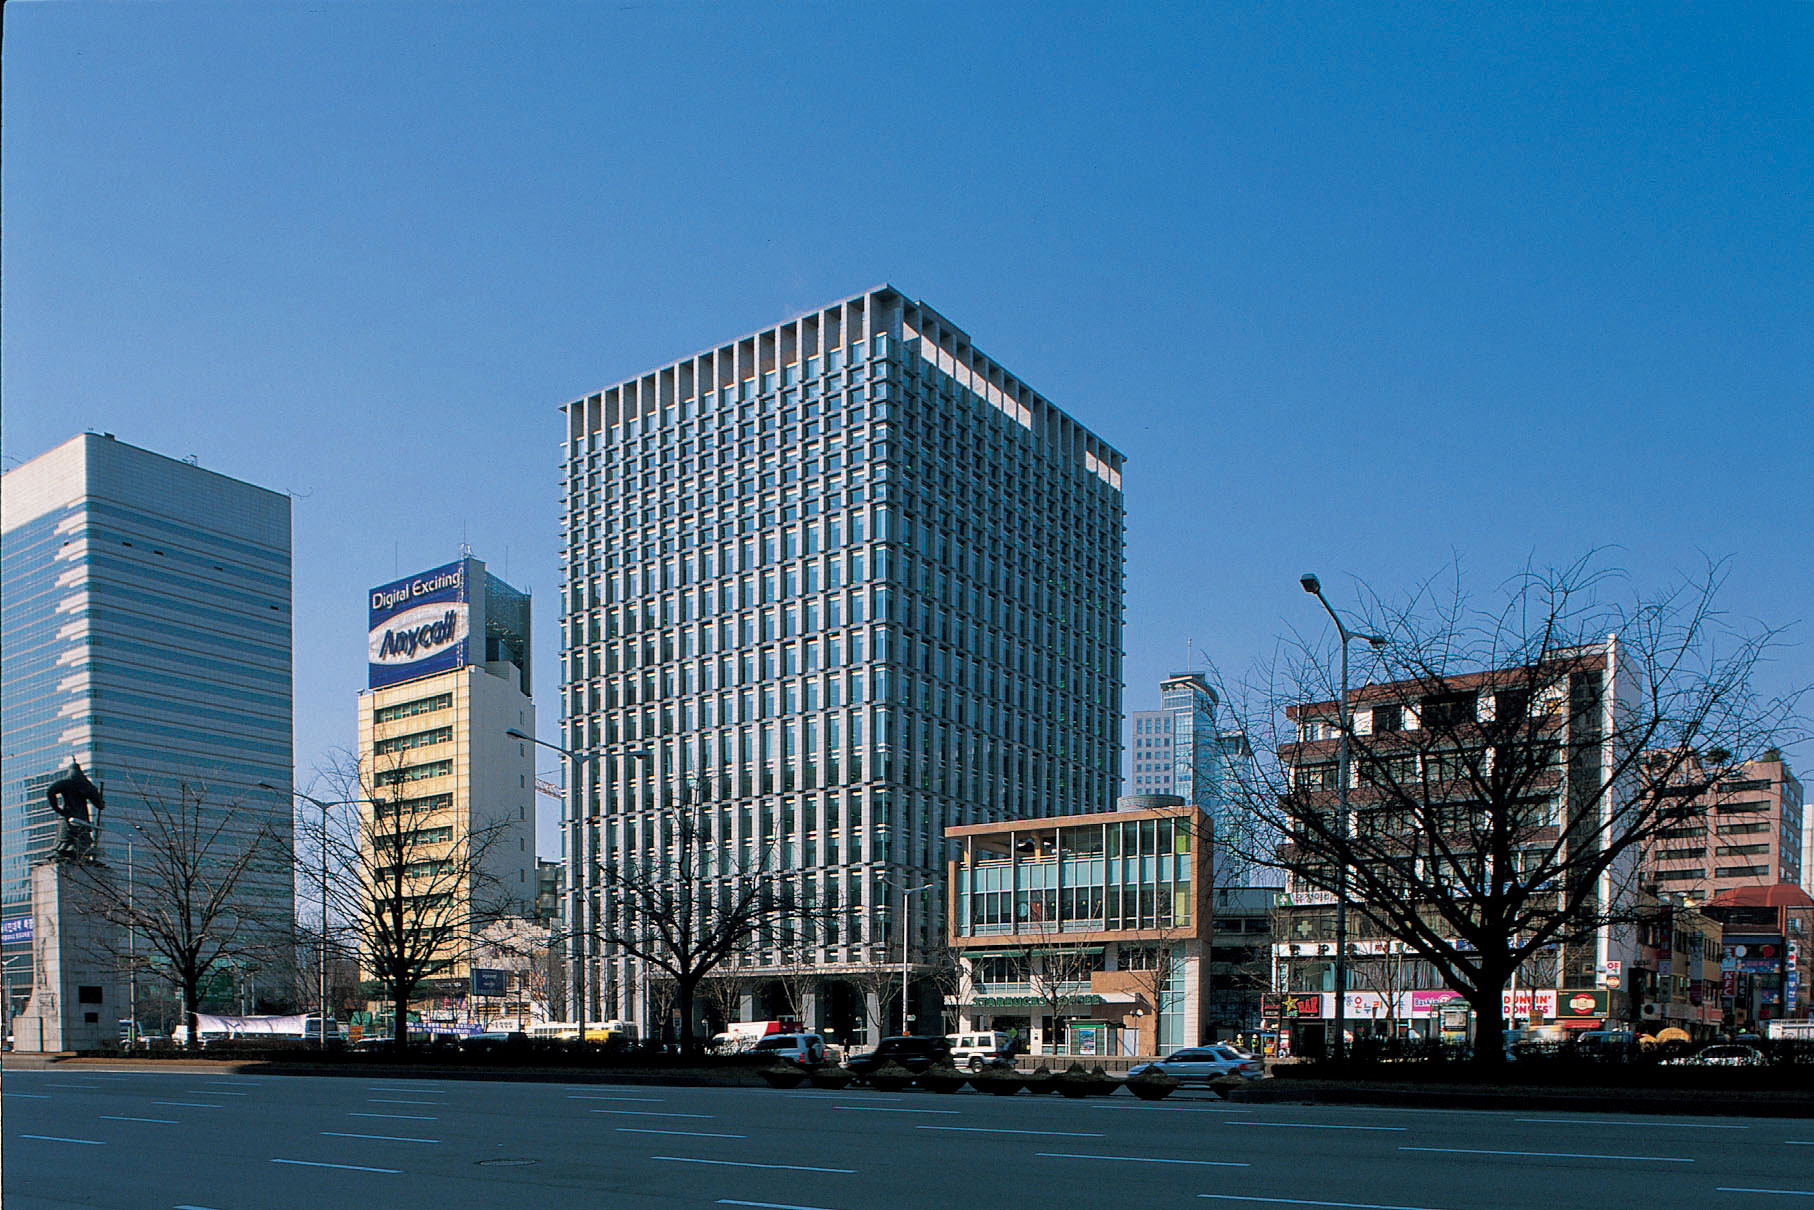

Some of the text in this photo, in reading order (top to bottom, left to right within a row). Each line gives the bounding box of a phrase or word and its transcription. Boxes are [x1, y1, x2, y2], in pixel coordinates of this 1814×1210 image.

[372, 573, 460, 609] Digital Exciting
[379, 610, 457, 660] Anycall
[1724, 972, 1733, 995] KFC
[972, 994, 1101, 1008] STARBUCKS OFFEE
[1297, 996, 1319, 1013] BAR
[1503, 1005, 1549, 1014] DONTS
